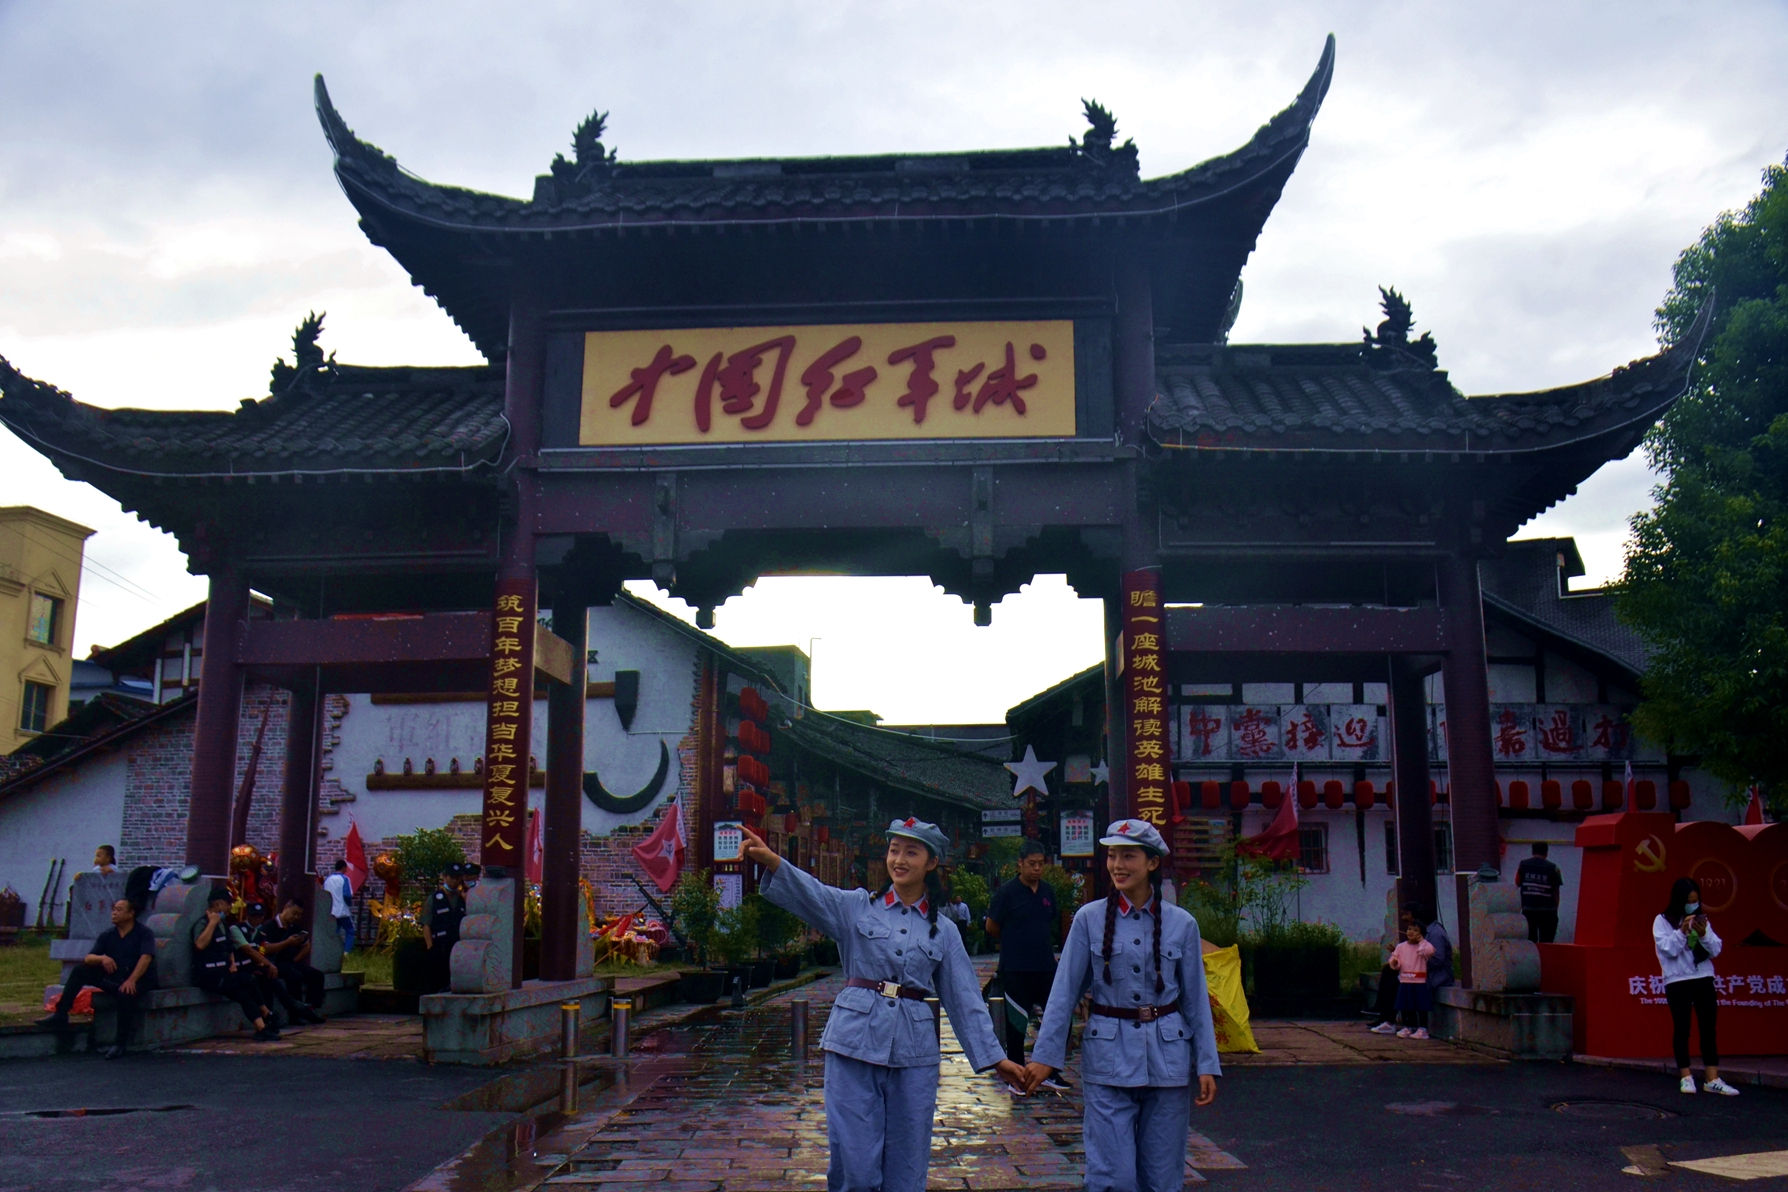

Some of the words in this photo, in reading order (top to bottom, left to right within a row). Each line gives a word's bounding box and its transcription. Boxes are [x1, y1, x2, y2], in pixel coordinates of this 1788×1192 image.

[484, 594, 524, 851] 筑百年梦想担当华夏复兴人
[1130, 590, 1168, 834] 瞻一座城池解读英雄生死
[1170, 707, 1376, 757] 迎接黨中
[1699, 877, 1726, 890] 1921
[1639, 997, 1653, 1006] The
[1732, 998, 1763, 1009] Founding
[1772, 999, 1785, 1007] The
